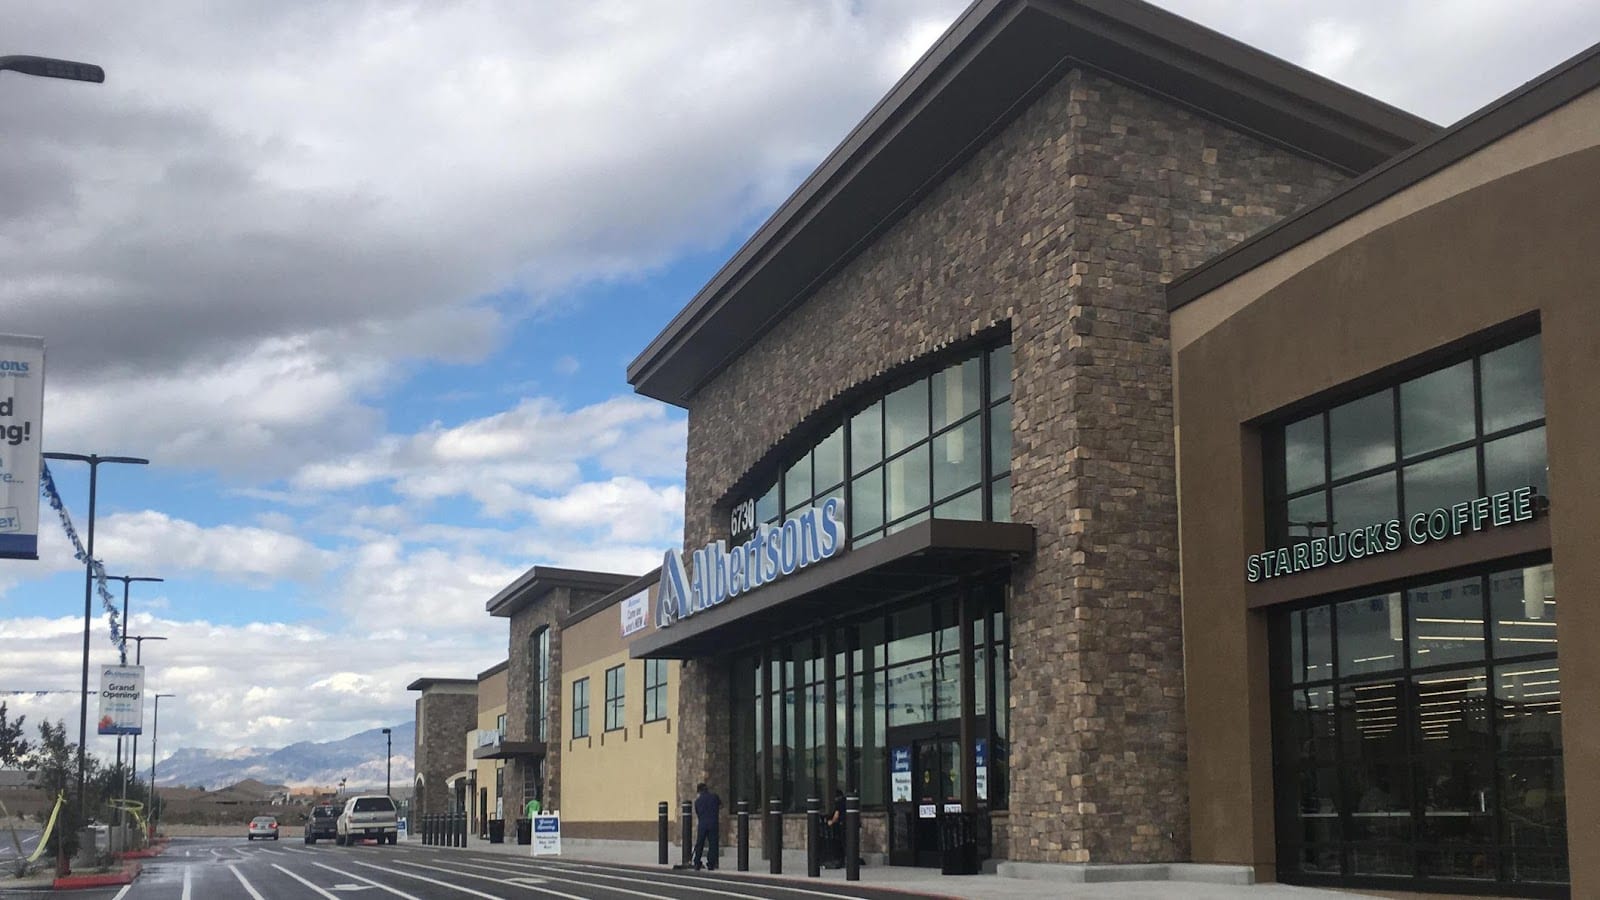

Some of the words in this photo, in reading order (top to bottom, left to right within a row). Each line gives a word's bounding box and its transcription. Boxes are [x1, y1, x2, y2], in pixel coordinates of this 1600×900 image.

[731, 498, 754, 537] 6730
[1247, 519, 1401, 582] STARBUCKS
[1408, 486, 1533, 545] COFFEE
[691, 497, 845, 614] Albertsons
[103, 690, 140, 700] Opening!
[108, 683, 135, 691] Grand
